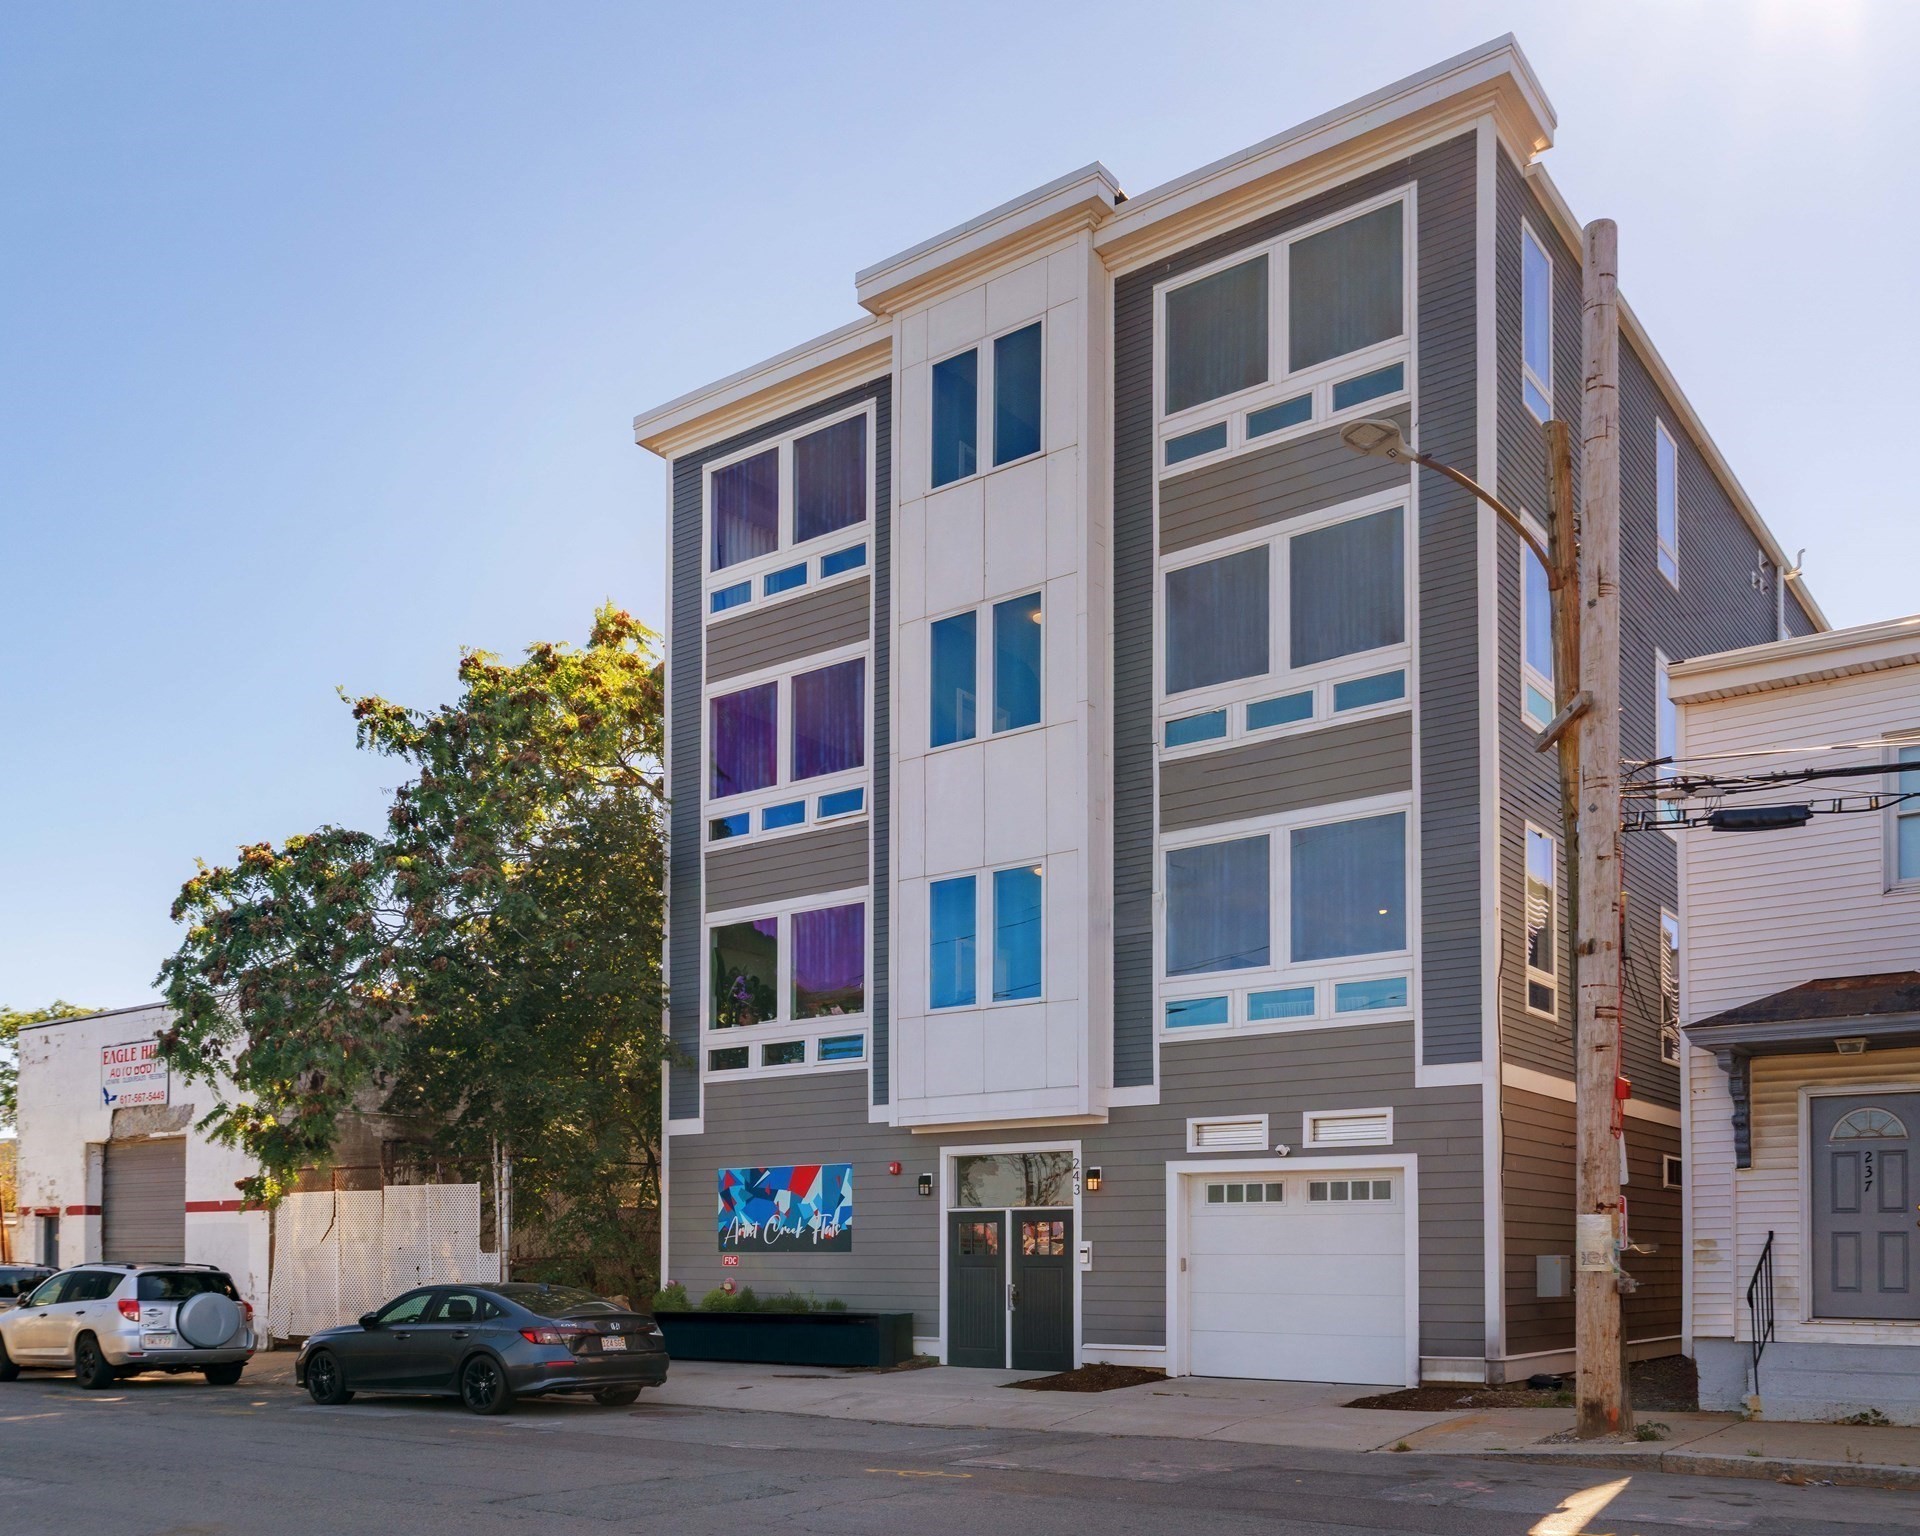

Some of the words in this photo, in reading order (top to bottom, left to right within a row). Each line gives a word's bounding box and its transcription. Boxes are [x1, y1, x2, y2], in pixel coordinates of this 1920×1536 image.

[103, 1047, 137, 1065] EAGLE
[141, 1044, 158, 1060] HI
[119, 1090, 165, 1105] 617-567-5449
[1072, 1157, 1080, 1196] 243
[1864, 1151, 1873, 1193] 237
[722, 1215, 761, 1246] Artist
[763, 1214, 806, 1245] Creek
[812, 1213, 842, 1245] Flats
[724, 1256, 737, 1265] FDC
